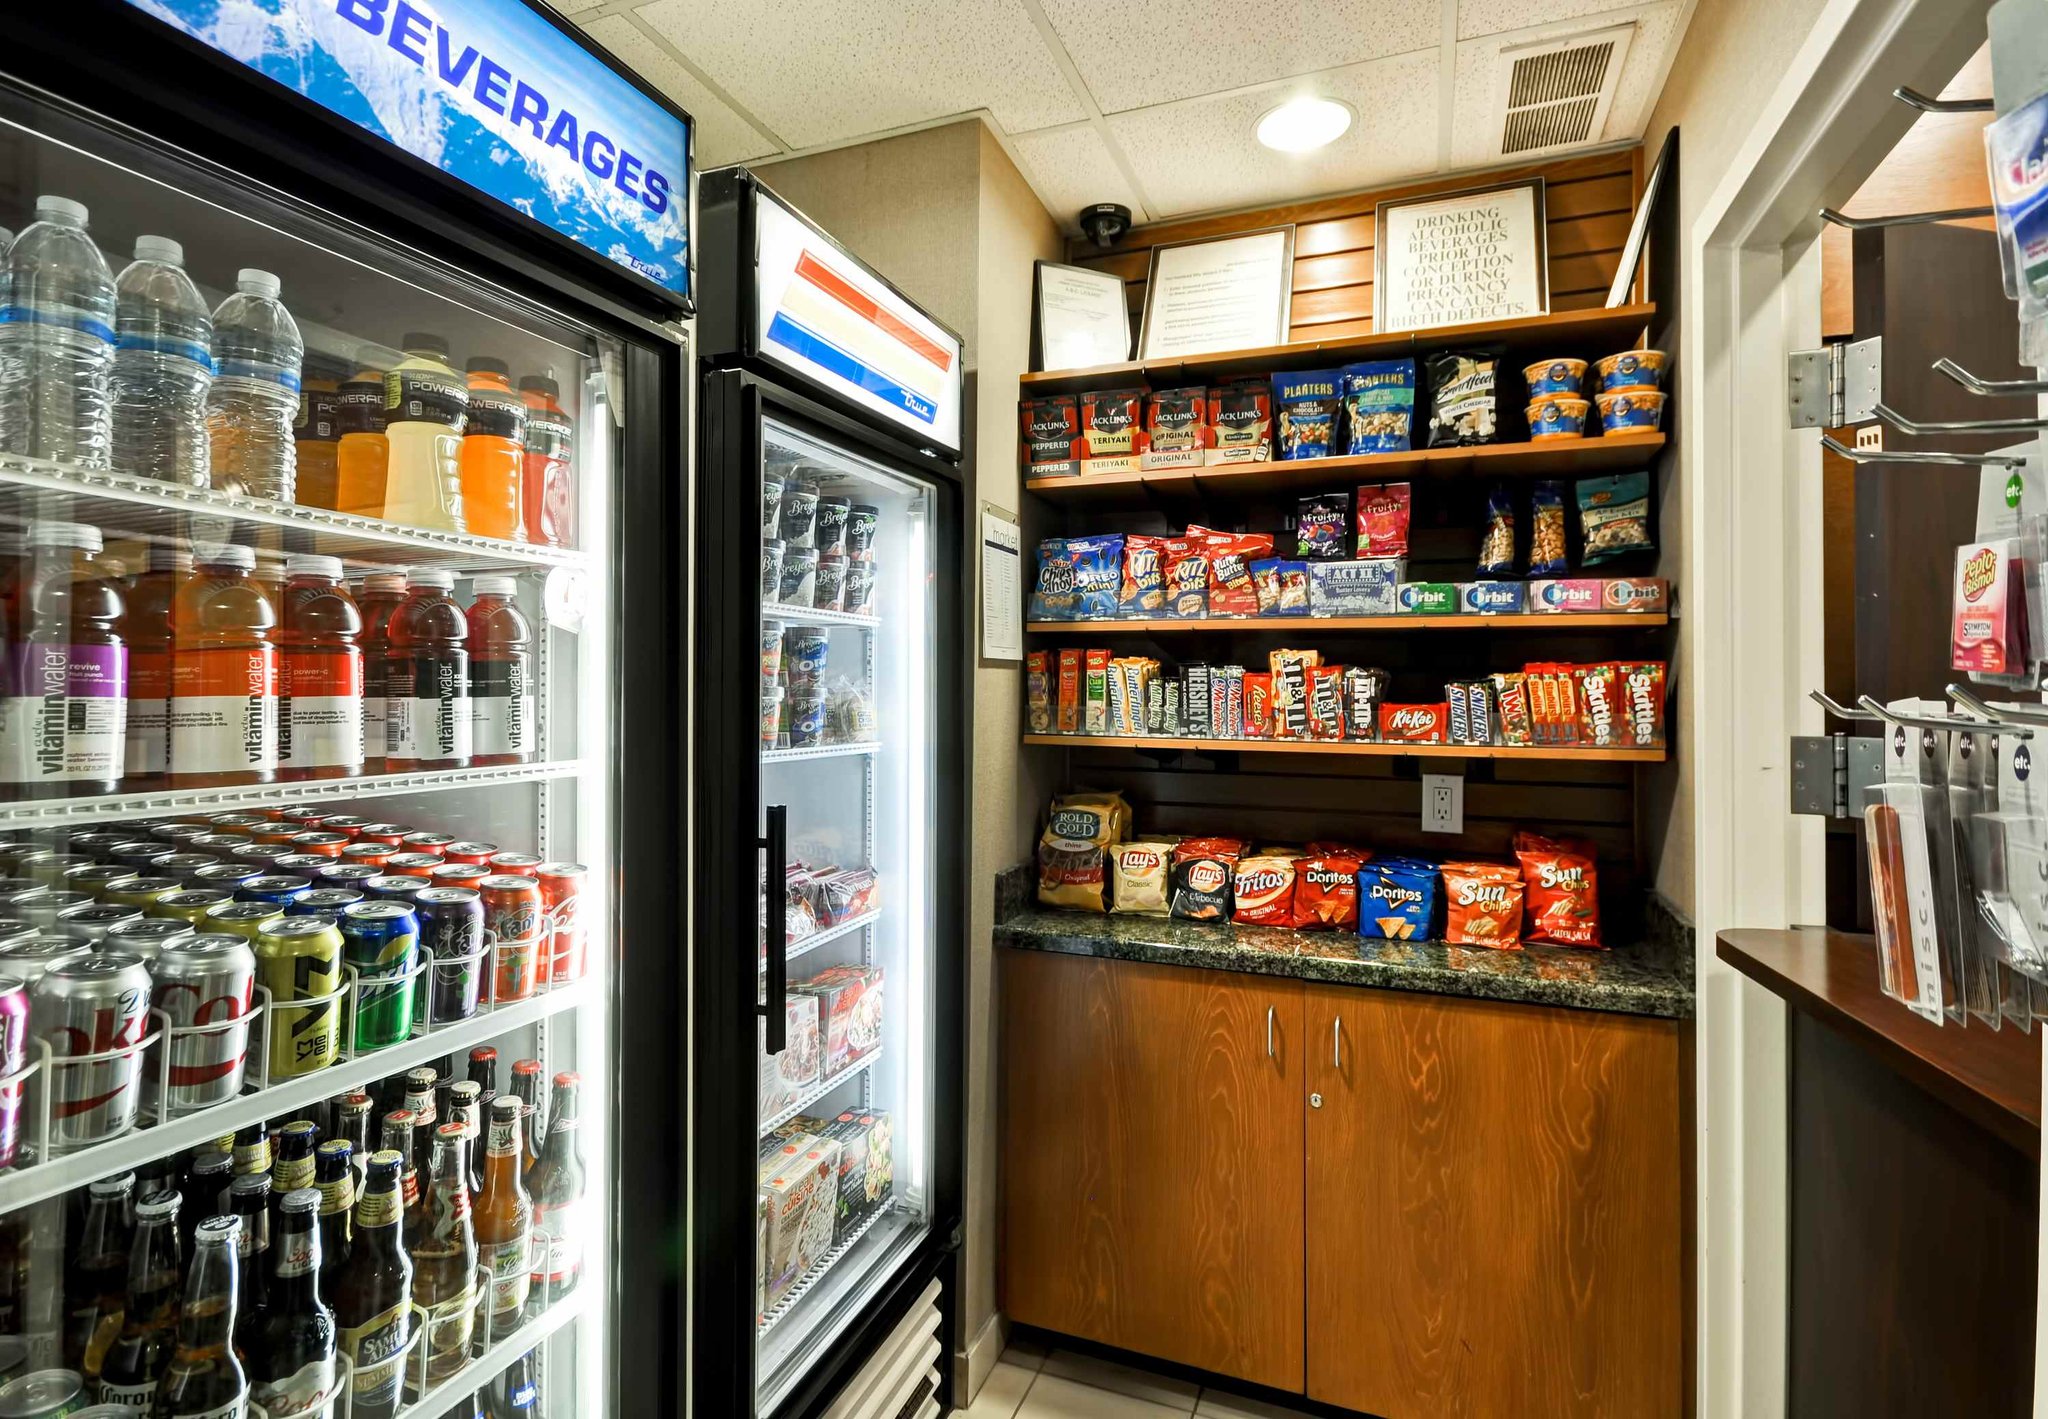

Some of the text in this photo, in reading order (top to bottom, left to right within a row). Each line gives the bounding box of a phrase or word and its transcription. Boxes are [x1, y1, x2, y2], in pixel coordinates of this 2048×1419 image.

[335, 0, 669, 215] BEVERAGES
[1409, 217, 1509, 241] ALCOHOLIC
[1417, 207, 1499, 229] DRINKING
[1409, 230, 1508, 253] BEVERAGES
[1420, 243, 1497, 264] PRIOR TO
[1403, 253, 1513, 277] CONCEPTION
[1411, 267, 1505, 289] OR DURING
[1407, 278, 1510, 302] PREGNANCY
[1411, 292, 1506, 313] CAN CAUSE
[1447, 302, 1528, 321] DEFECTS.
[1284, 383, 1333, 398] PLANTERS
[1438, 372, 1494, 400] Smartfood
[900, 389, 931, 417] true
[1031, 441, 1069, 451] PEPPERED
[1093, 435, 1131, 445] TERIYAKI
[1156, 431, 1195, 441] ORIGINAL
[1031, 463, 1070, 473] PEPPERED
[1092, 459, 1129, 469] TERIYAKI
[1151, 453, 1192, 463] ORIGINAL
[2006, 484, 2023, 498] etc.
[993, 528, 1018, 550] market
[1131, 550, 1160, 578] RITZ
[1174, 560, 1207, 582] RITZ
[1216, 563, 1245, 581] Butter
[1333, 567, 1373, 579] ACT II
[1041, 567, 1072, 584] Chips
[1966, 565, 1995, 595] Bismol
[1400, 587, 1446, 612] Orbit
[1466, 587, 1514, 612] Orbit
[1541, 583, 1593, 610] Orbit
[1605, 580, 1660, 606] Orbit
[1963, 622, 1968, 637] 5
[1968, 622, 1991, 631] SYMPTOM
[293, 668, 328, 677] power-c
[245, 652, 264, 763] vitaminwater
[438, 662, 453, 755] vitaminwater
[508, 663, 521, 749] vitaminwater
[1108, 665, 1125, 730] Butterfinger
[1126, 666, 1144, 733] Butterfinger
[37, 648, 66, 774] vitaminwater
[278, 660, 291, 761] vitaminwater
[1450, 687, 1468, 741] SNICKERS
[1470, 688, 1489, 742] SNICKERS
[1583, 676, 1612, 745] Skittles
[1629, 673, 1656, 745] Skittles
[1894, 735, 1906, 748] etc.
[2014, 753, 2031, 770] etc.
[1060, 812, 1093, 823] ROLD
[1055, 822, 1094, 836] GOLD
[1065, 873, 1090, 883] Original
[1127, 880, 1152, 888] Classic
[1235, 870, 1284, 897] Fritos
[1307, 871, 1354, 885] Doritos
[1540, 865, 1583, 888] Sun
[1562, 879, 1590, 892] Chips
[1372, 885, 1423, 902] Doritos
[1458, 880, 1506, 906] Sun
[1249, 904, 1277, 916] ORIGINAL
[1480, 899, 1514, 914] Chips
